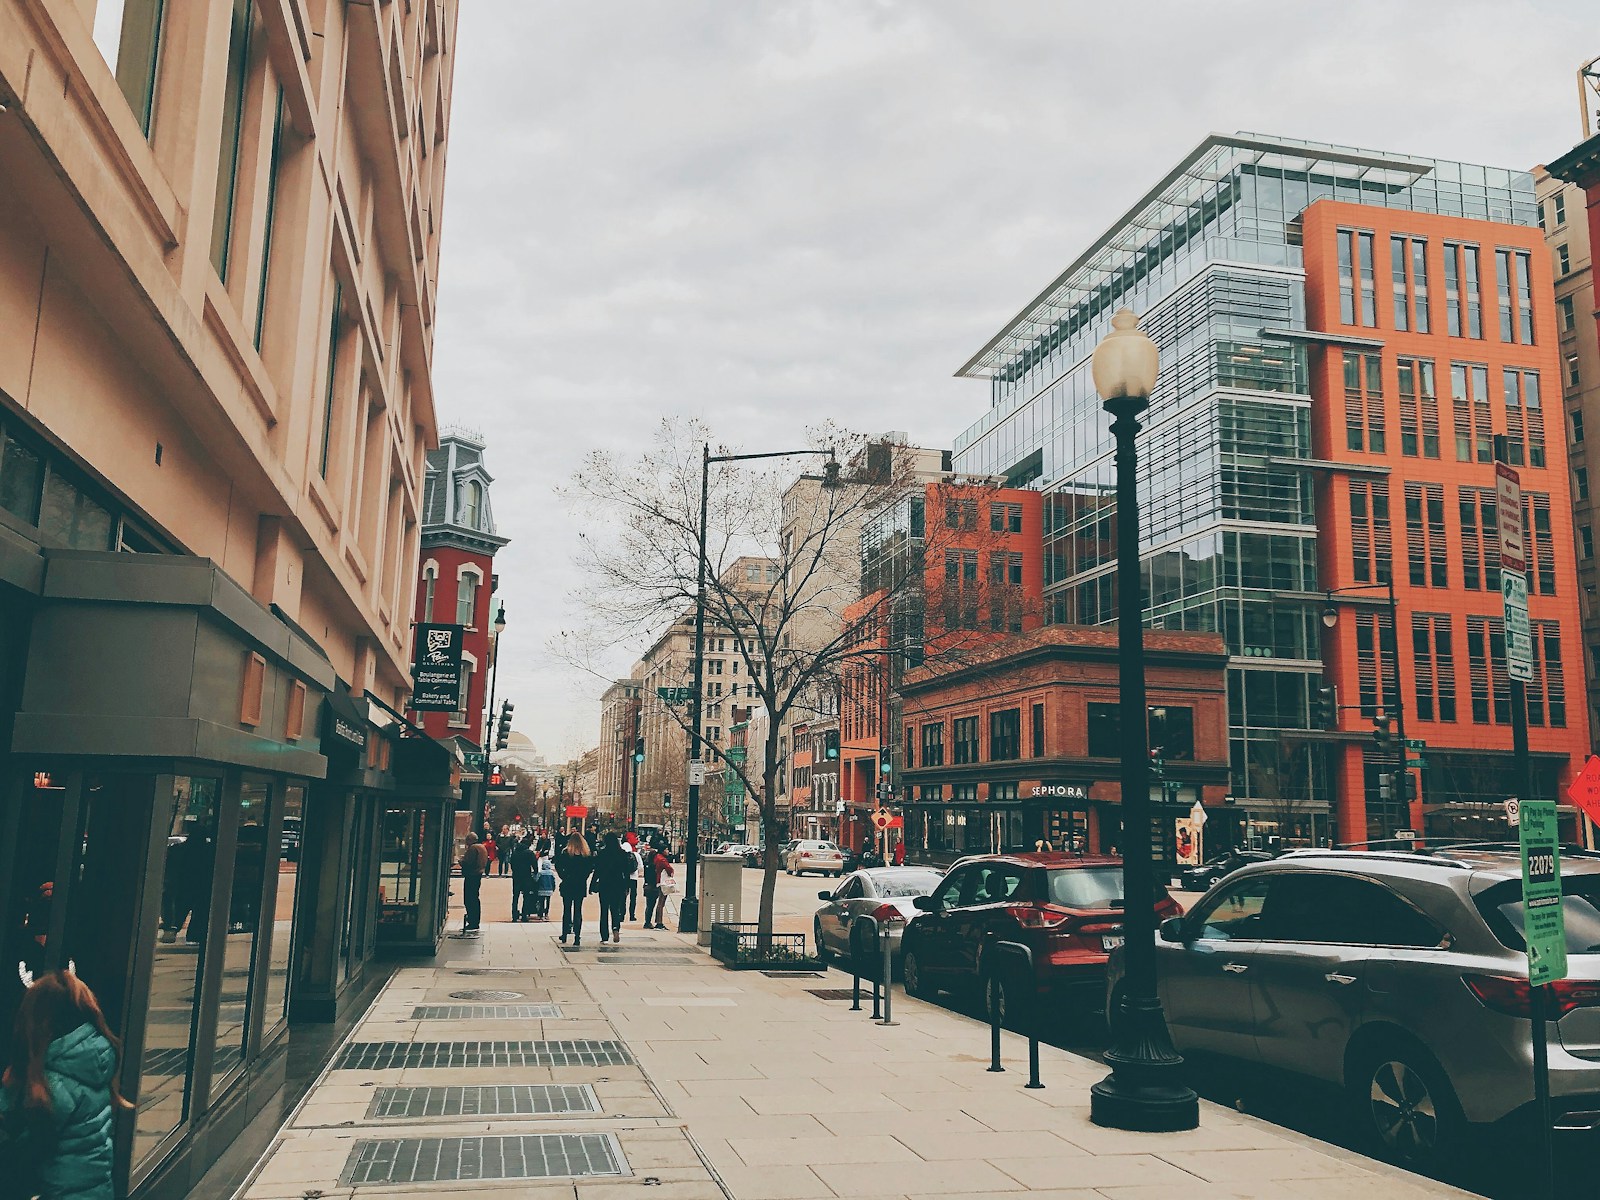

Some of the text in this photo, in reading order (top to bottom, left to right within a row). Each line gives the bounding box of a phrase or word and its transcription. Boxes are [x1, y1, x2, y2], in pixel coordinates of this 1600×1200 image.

[668, 688, 675, 698] F
[1032, 786, 1083, 796] SEPHORA
[1528, 855, 1554, 876] 22079
